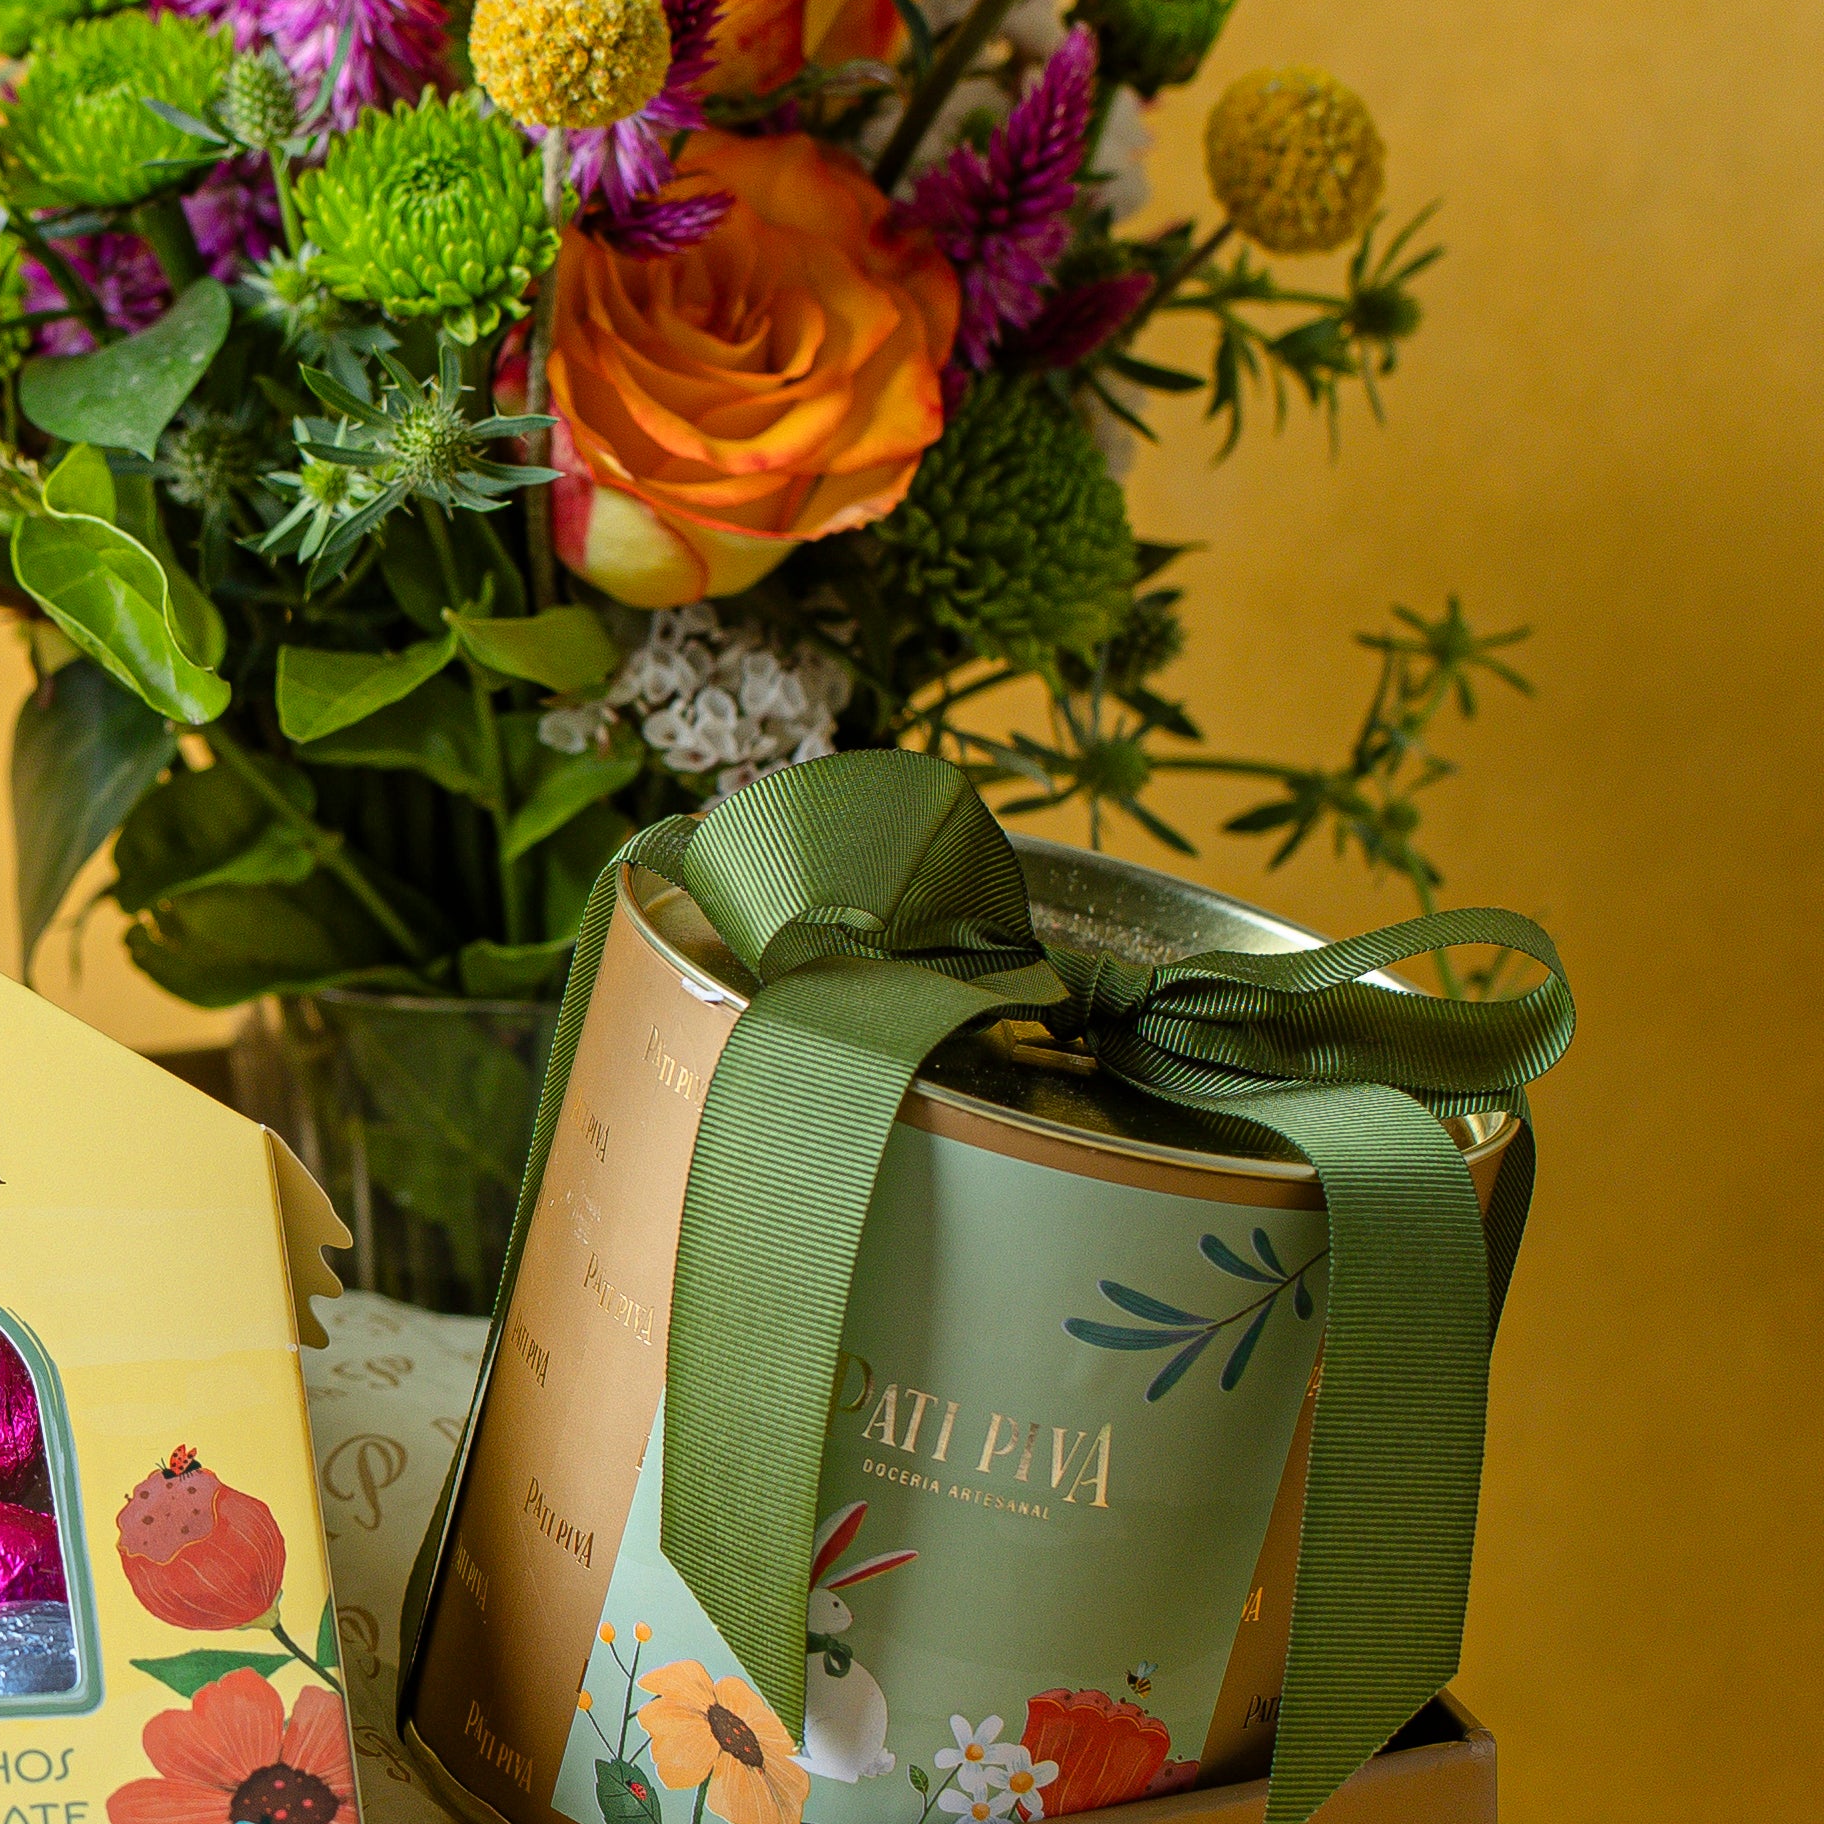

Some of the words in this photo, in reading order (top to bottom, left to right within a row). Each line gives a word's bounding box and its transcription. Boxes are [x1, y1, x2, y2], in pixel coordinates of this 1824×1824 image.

[642, 1024, 676, 1086] PATI
[582, 1252, 615, 1310] PATI
[614, 1291, 654, 1346] PIVA
[526, 1340, 552, 1389] PIVA
[826, 1351, 960, 1462] PATI
[975, 1411, 1112, 1508] PIVA
[523, 1476, 554, 1541] PATI
[554, 1518, 595, 1571] PIVA
[862, 1458, 941, 1494] DOCERIA
[948, 1485, 1051, 1521] ARTESANAL
[464, 1699, 495, 1763] PATI
[495, 1743, 534, 1795] PIVA
